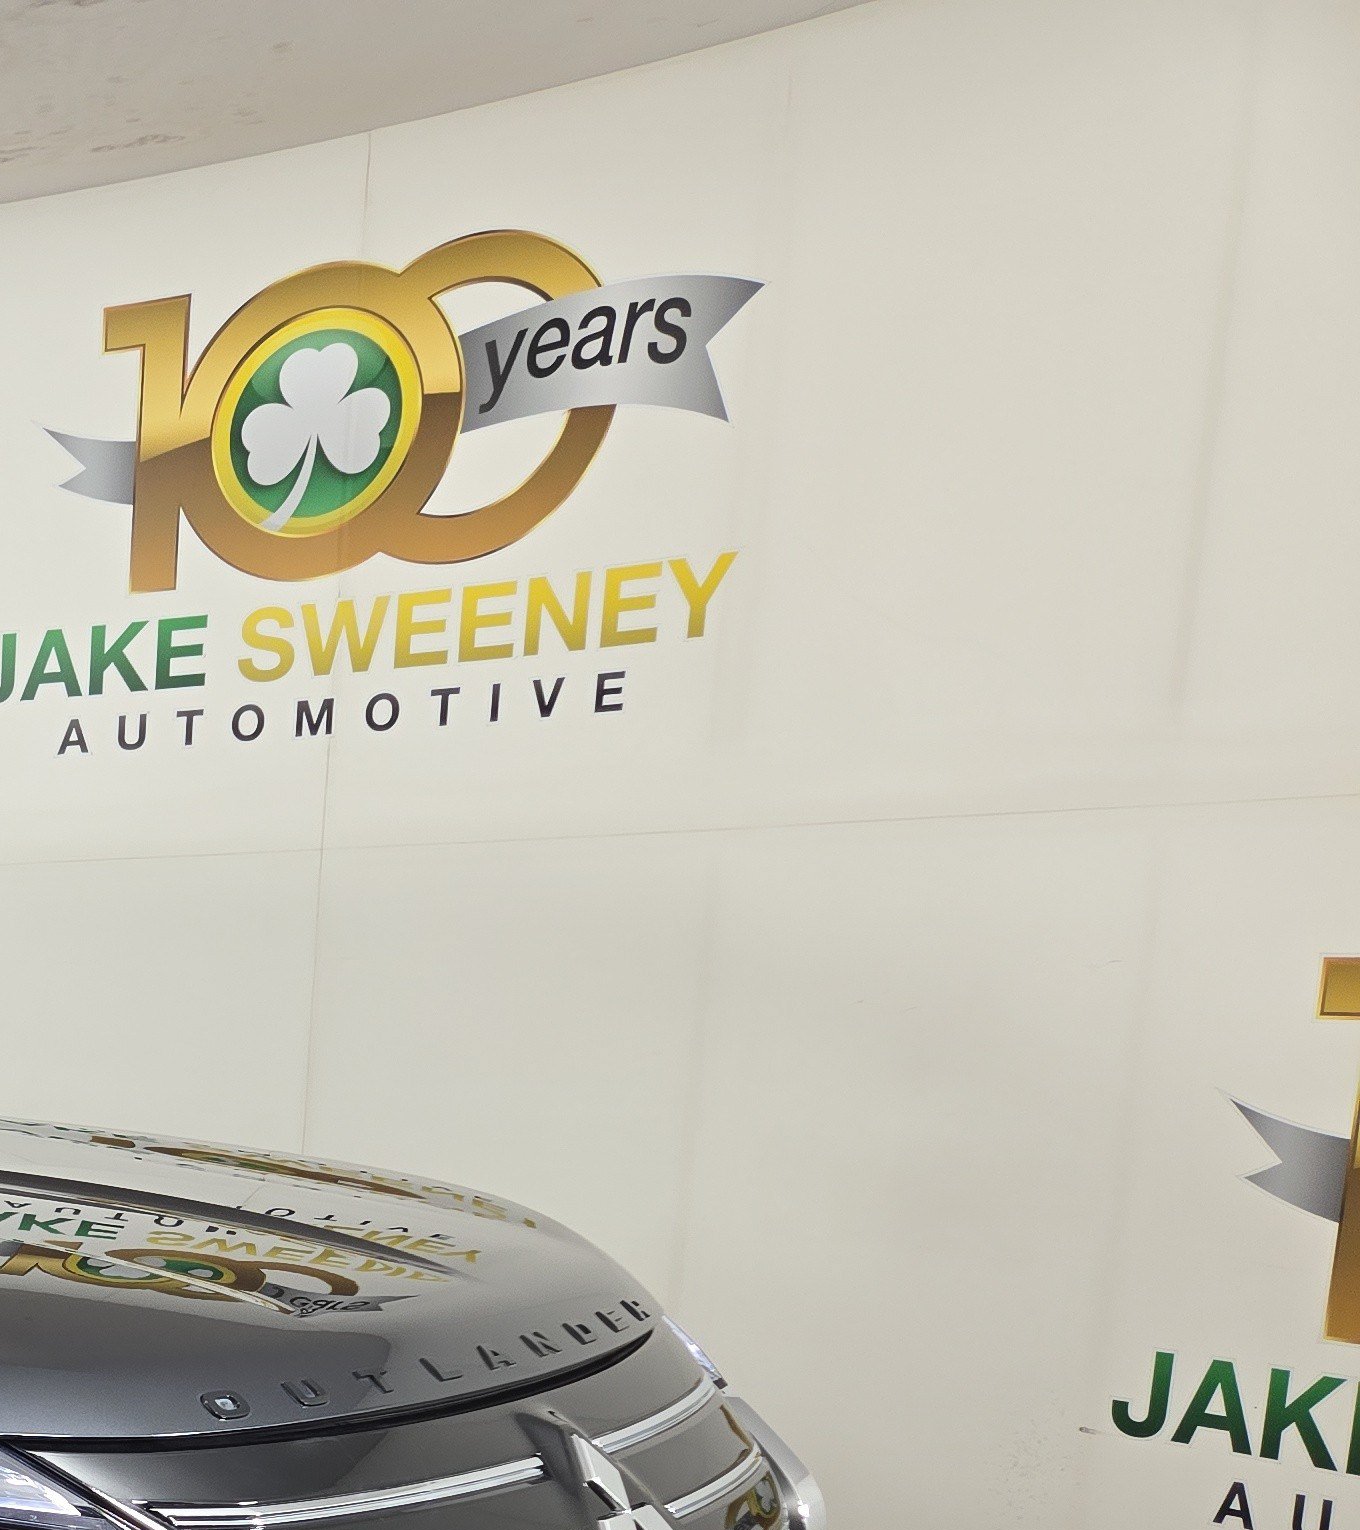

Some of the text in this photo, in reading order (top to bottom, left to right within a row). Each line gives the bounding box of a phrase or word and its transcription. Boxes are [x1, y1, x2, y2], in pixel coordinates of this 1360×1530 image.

[479, 293, 694, 412] years
[237, 551, 739, 683] SWEENEY
[57, 670, 628, 756] AUTOMOTIVE
[200, 1297, 652, 1421] OUTLANDER
[1111, 1350, 1360, 1476] JAK
